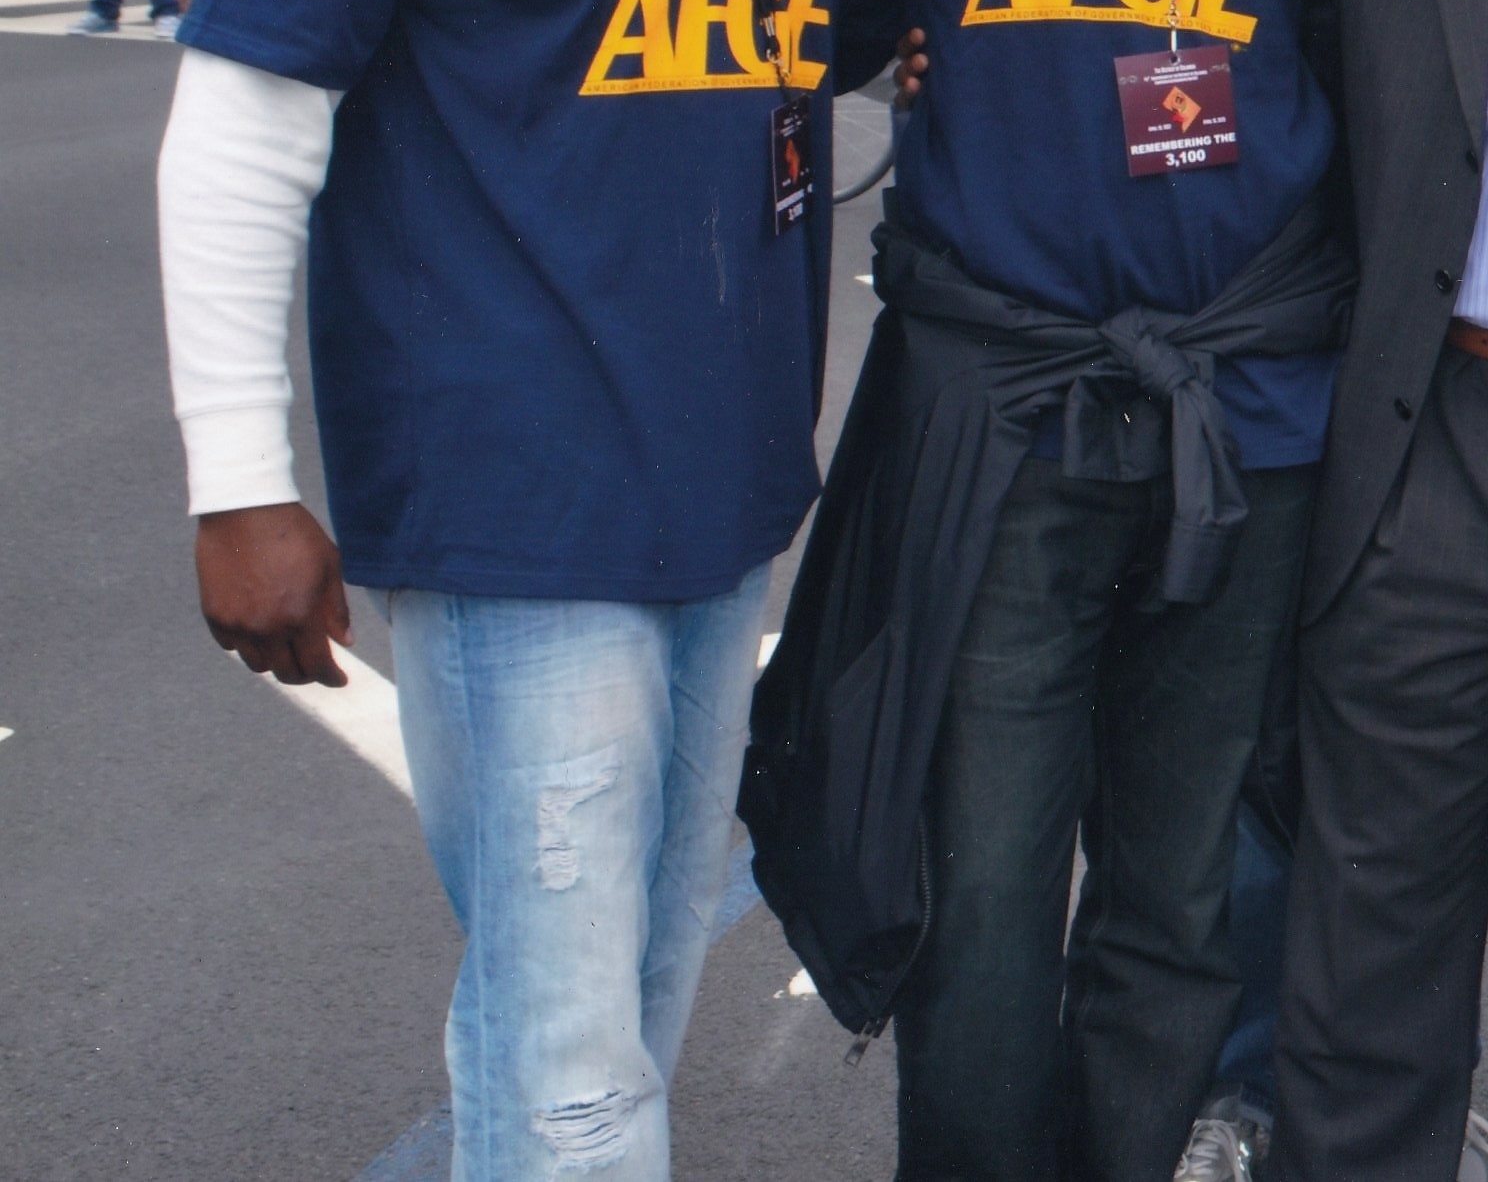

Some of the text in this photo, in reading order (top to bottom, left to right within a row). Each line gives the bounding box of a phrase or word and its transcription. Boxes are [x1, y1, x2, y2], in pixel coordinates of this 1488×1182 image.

[1130, 132, 1236, 155] REMEMBERING THE
[1165, 149, 1207, 167] 3,100
